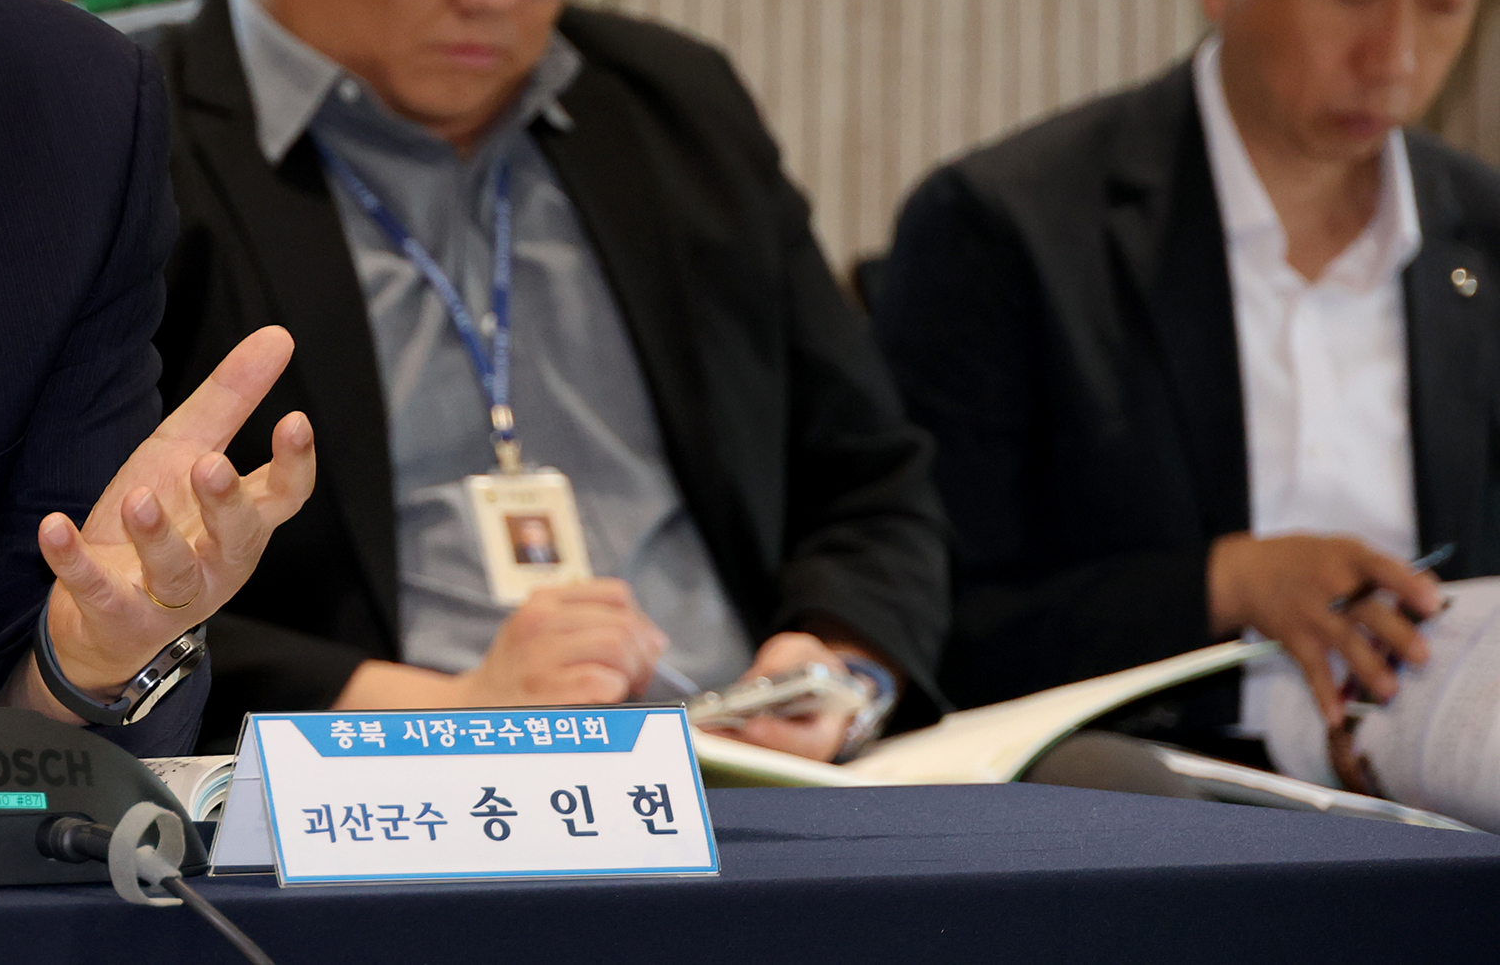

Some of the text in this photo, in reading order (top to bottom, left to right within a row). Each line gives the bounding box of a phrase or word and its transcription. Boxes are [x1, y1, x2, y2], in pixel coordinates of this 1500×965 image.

[329, 716, 611, 749] 충북 시장·군수협의회
[16, 795, 41, 806] #87
[301, 782, 679, 844] 괴산군수 송 인 헌
